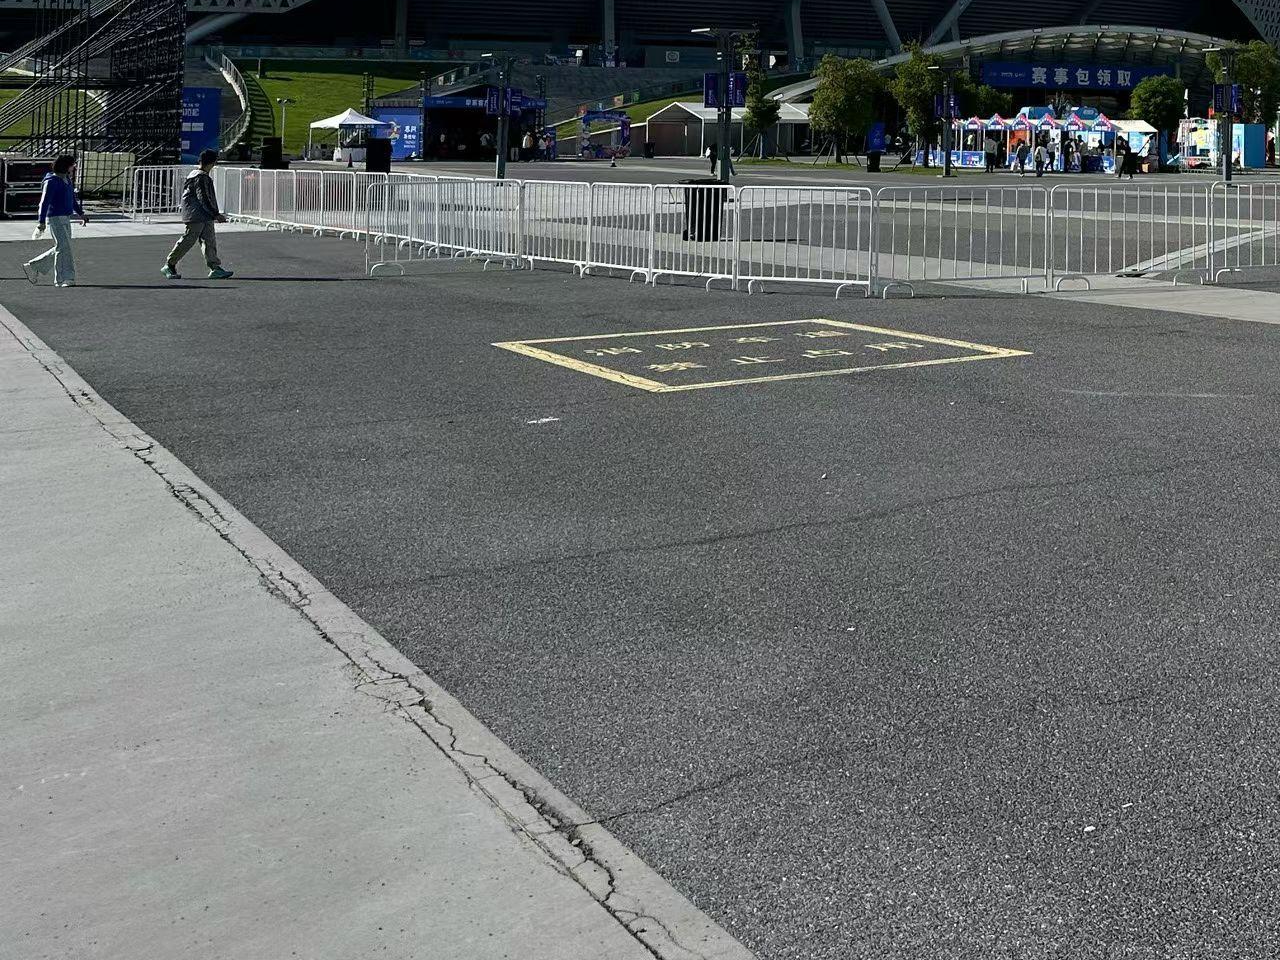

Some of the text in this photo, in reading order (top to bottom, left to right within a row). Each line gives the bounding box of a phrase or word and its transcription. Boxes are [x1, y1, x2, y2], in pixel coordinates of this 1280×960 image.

[1031, 66, 1132, 87] 赛事包领取
